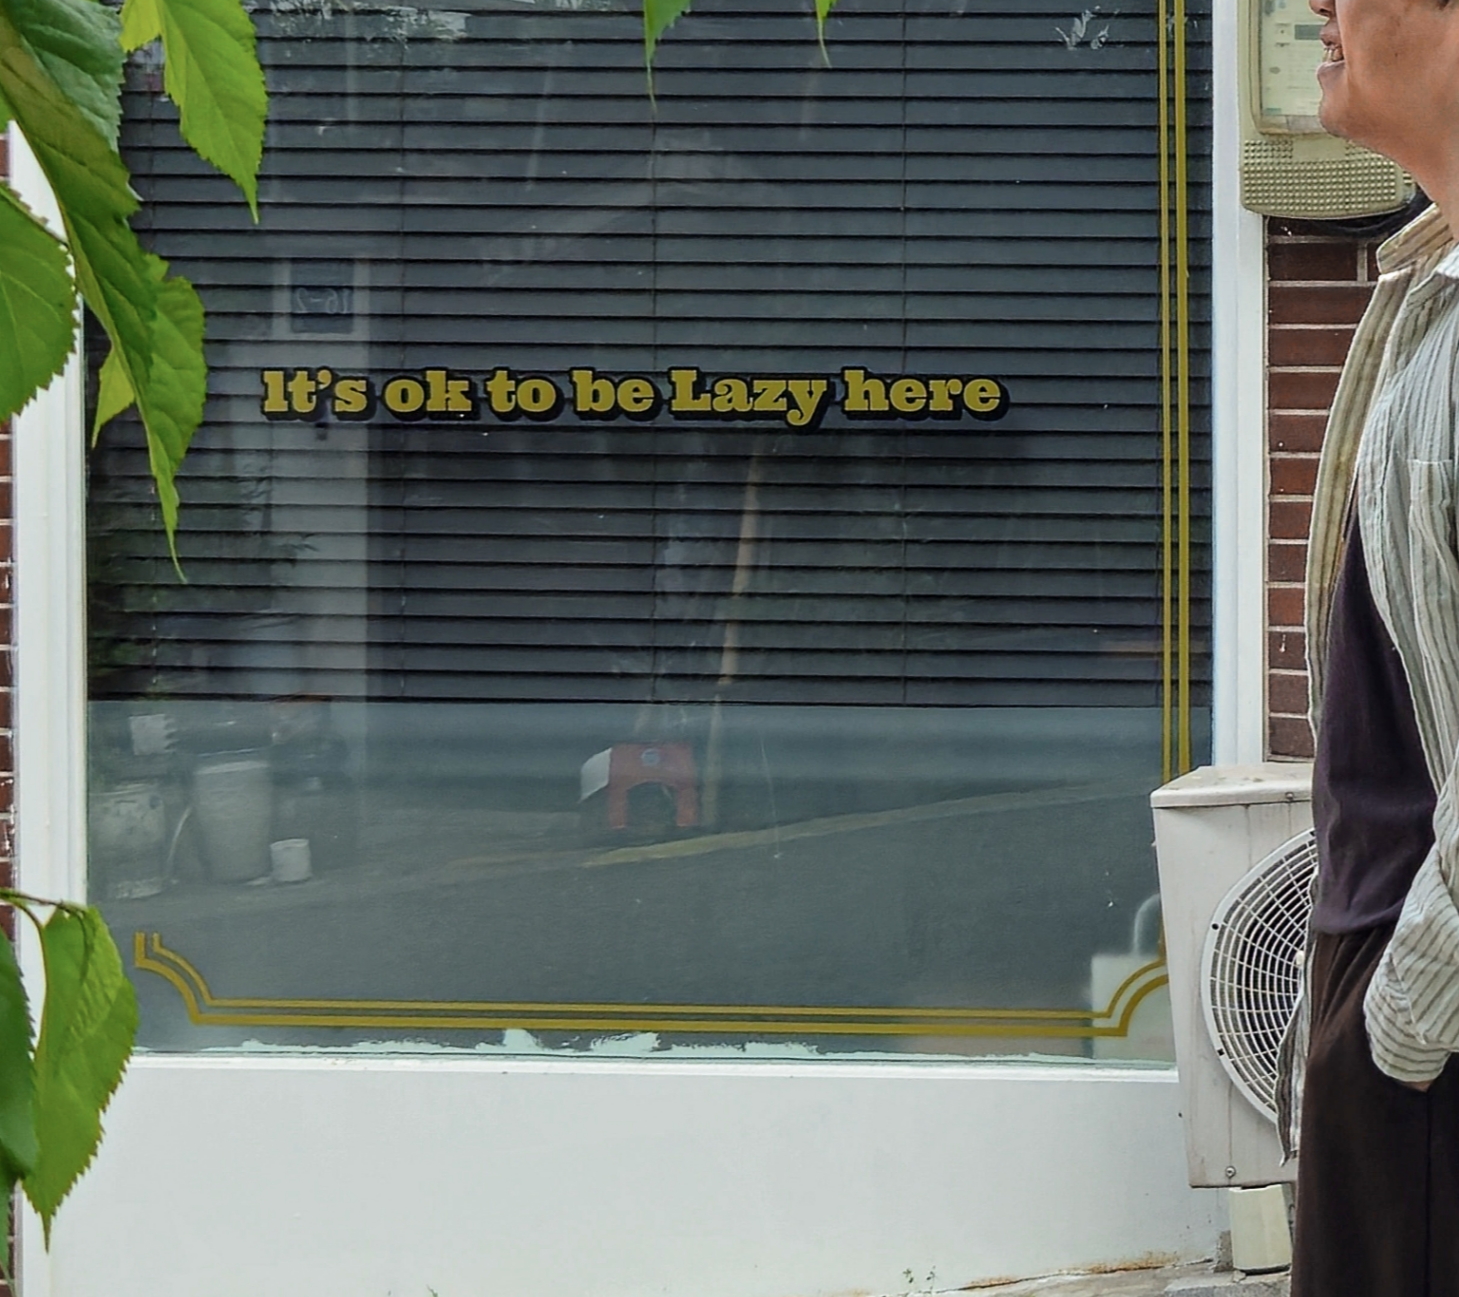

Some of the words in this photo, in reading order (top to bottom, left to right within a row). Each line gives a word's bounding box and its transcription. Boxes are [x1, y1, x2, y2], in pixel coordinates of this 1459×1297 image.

[262, 368, 369, 414] It's
[384, 368, 474, 414] ok
[486, 368, 558, 414] to
[571, 368, 657, 414] be
[670, 368, 829, 427] Lazy
[843, 368, 1002, 414] here
